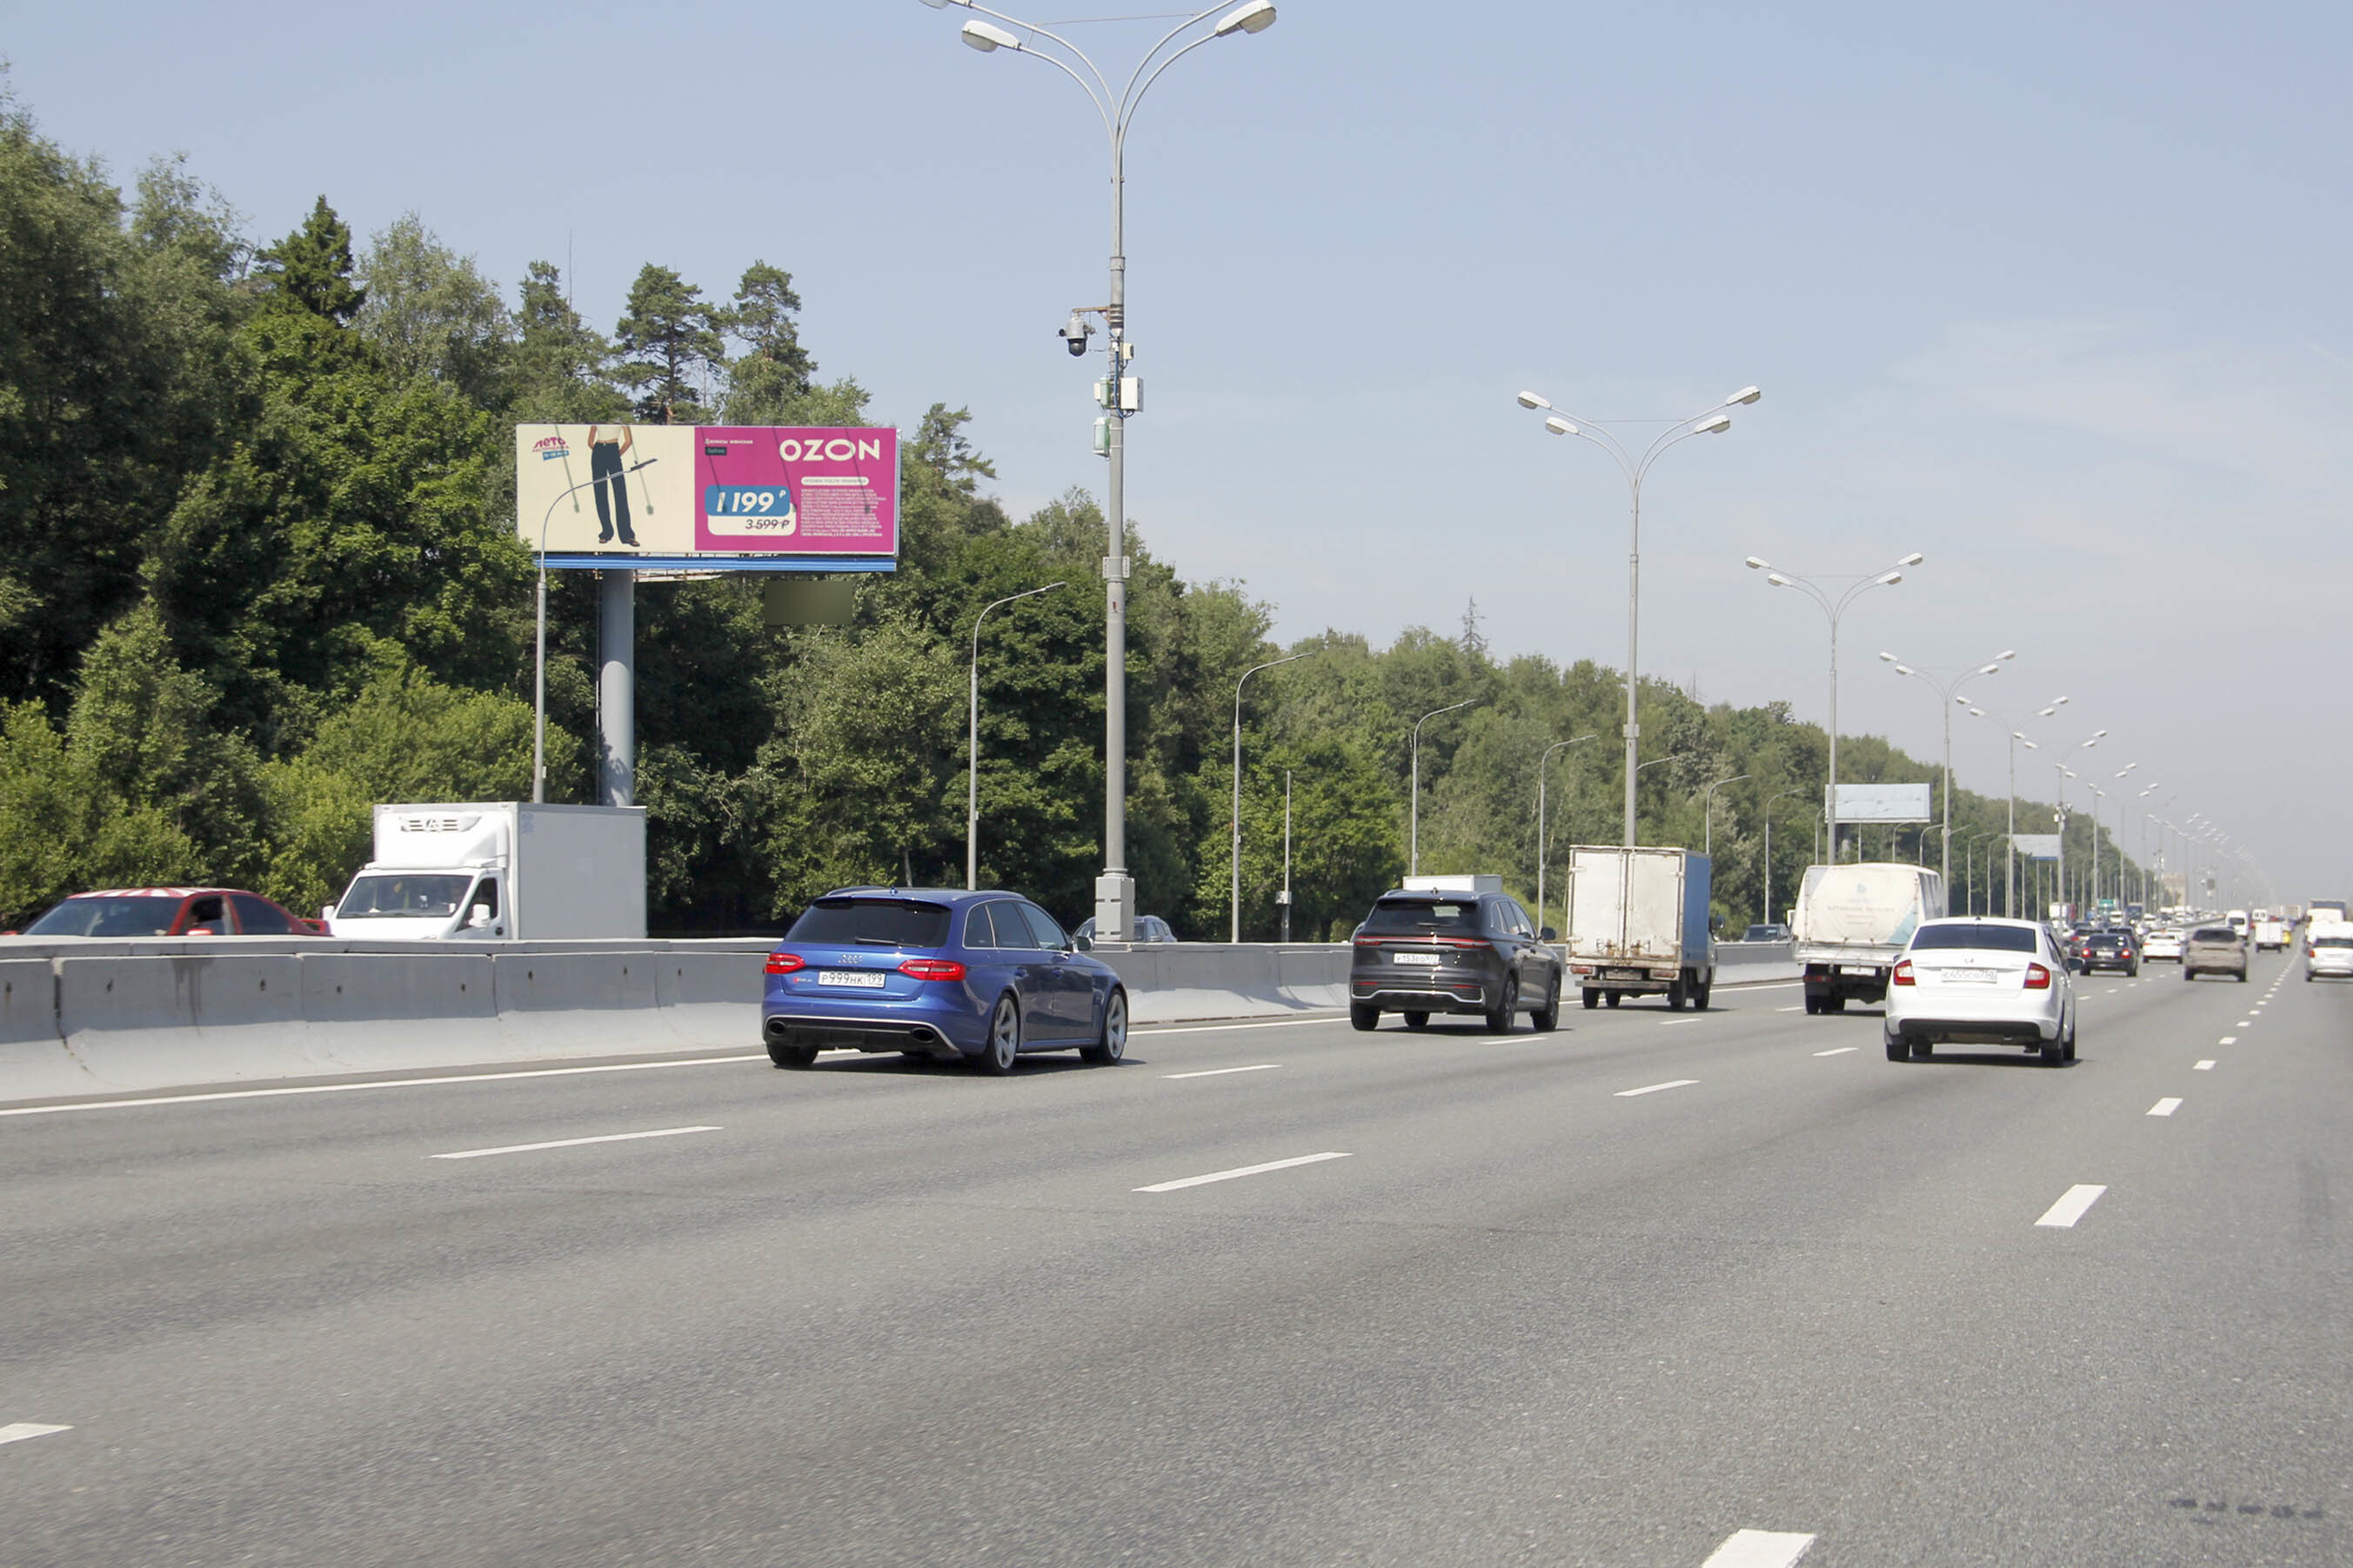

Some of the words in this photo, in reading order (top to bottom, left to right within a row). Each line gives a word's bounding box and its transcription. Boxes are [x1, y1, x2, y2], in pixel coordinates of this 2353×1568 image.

[779, 438, 880, 462] OZON
[732, 491, 774, 513] 199
[755, 518, 779, 530] 599
[822, 972, 864, 984] Р999НК
[867, 973, 883, 983] 199
